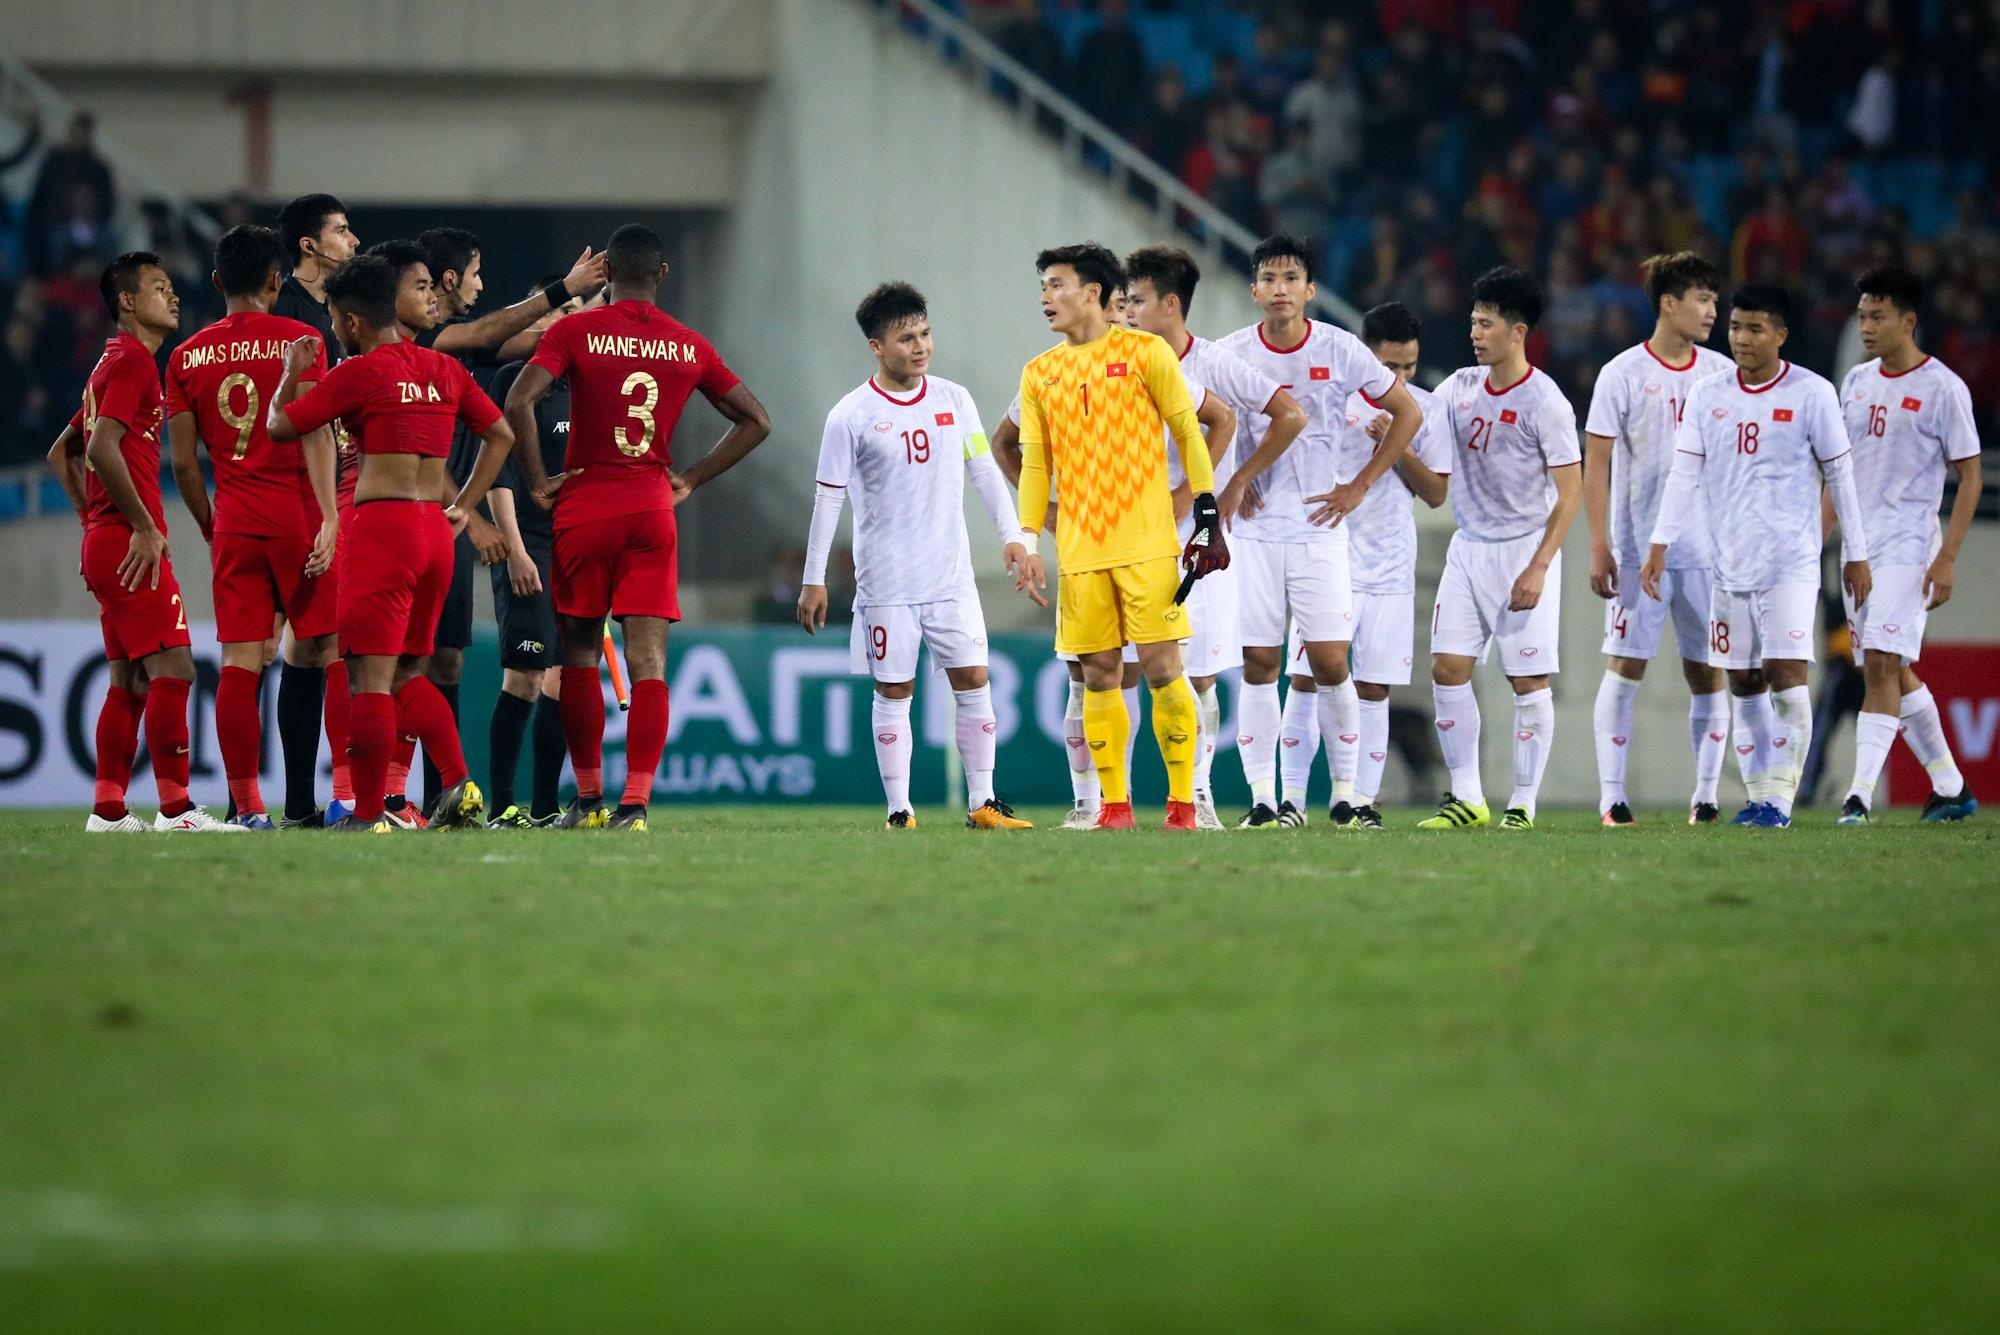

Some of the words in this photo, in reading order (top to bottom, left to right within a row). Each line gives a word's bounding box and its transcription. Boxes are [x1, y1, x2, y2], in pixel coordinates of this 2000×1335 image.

[182, 344, 227, 370] DIMAS
[587, 333, 680, 362] WANEWAR
[683, 343, 697, 364] M
[217, 373, 259, 461] 9
[614, 371, 659, 458] 3
[1079, 383, 1089, 417] 1
[1468, 416, 1493, 454] 21
[1868, 404, 1887, 438] 16
[900, 429, 930, 465] 19
[1737, 422, 1759, 455] 18
[1611, 605, 1628, 640] 14
[1711, 620, 1730, 654] 18
[516, 639, 545, 654] AFC
[868, 624, 887, 661] 19
